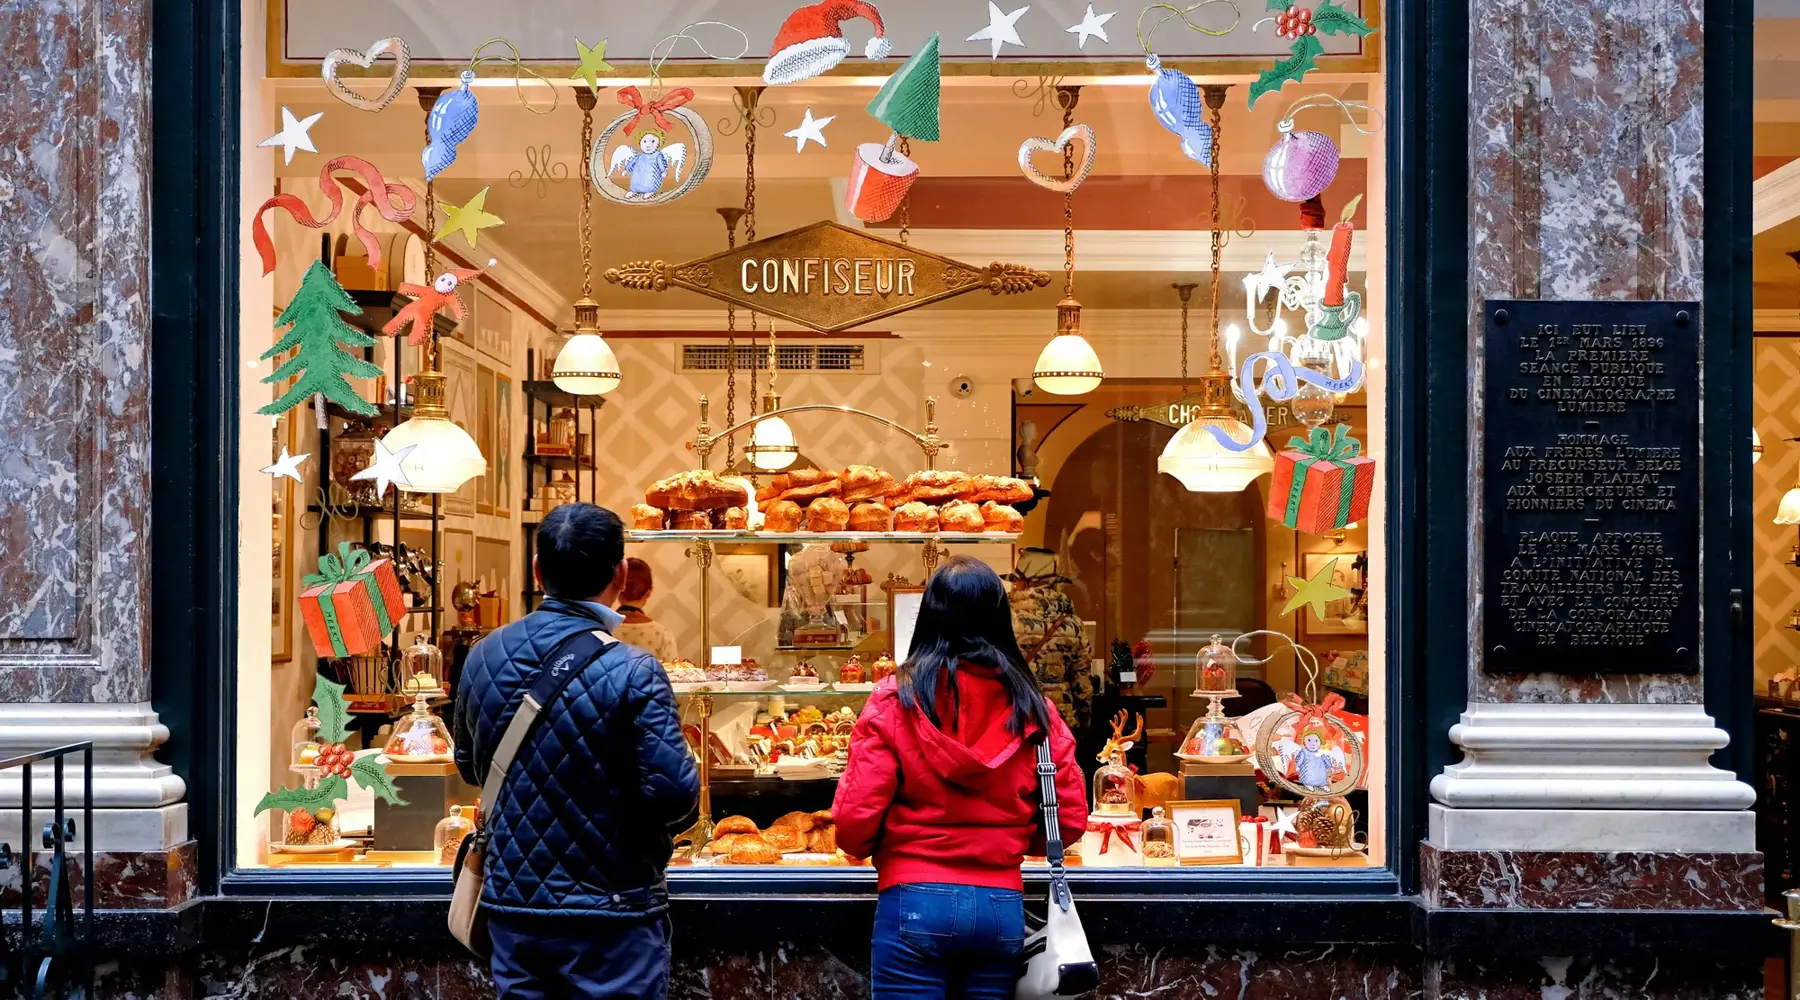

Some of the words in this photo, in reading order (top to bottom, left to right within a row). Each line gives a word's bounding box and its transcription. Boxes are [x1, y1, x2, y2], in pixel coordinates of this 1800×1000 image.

[740, 257, 916, 296] CONFISEUR
[1538, 324, 1558, 335] ICI
[1572, 325, 1602, 335] EUT
[1613, 325, 1646, 335] LIEU
[1520, 337, 1539, 347] LE
[1580, 337, 1622, 348] MARS
[1535, 350, 1555, 360] LA
[1568, 351, 1649, 361] PREMIERE
[1520, 363, 1579, 373] SEANCE
[1590, 363, 1664, 375] PUBLIQUE
[1543, 376, 1561, 386] EN
[1572, 376, 1645, 388] BELGIQUE
[1510, 389, 1528, 398] DU
[1537, 389, 1675, 400] CINEMATOGRAPHE
[1558, 402, 1626, 412] LUMIERE
[1557, 434, 1629, 445] HOMMAGE
[1504, 447, 1535, 457] AUX
[1545, 447, 1603, 458] FRERES
[1616, 448, 1680, 458] LUMIERE
[1501, 460, 1521, 470] AU
[1529, 460, 1627, 471] PRECURSEUR
[1636, 461, 1681, 471] BELGE
[1525, 473, 1584, 483] JOSEPH
[1593, 473, 1659, 484] PLATEAU
[1507, 486, 1537, 496] AUX
[1547, 486, 1645, 496] CHERCHEURS
[1657, 486, 1676, 497] ET
[1506, 499, 1585, 509] PIONNIERS
[1595, 499, 1614, 509] DU
[1622, 499, 1676, 510] CINEMA
[1520, 532, 1578, 543] PLAQUE
[1593, 532, 1662, 543] APPOSEE
[1518, 544, 1537, 554] LE
[1577, 544, 1620, 555] MARS
[1511, 557, 1522, 567] A
[1655, 558, 1673, 568] DU
[1503, 570, 1560, 580] COMITE
[1570, 570, 1645, 581] NATIONAL
[1652, 571, 1680, 581] DES
[1500, 582, 1614, 594] TRAVAILLEURS
[1622, 584, 1641, 594] DU
[1650, 584, 1683, 594] FILM
[1500, 596, 1519, 606] ET
[1527, 596, 1564, 606] AVEC
[1575, 596, 1592, 606] LE
[1604, 597, 1679, 607] CONCOURS
[1509, 609, 1526, 619] DE
[1538, 609, 1556, 619] LA
[1569, 609, 1672, 620] CORPORATION
[1513, 621, 1669, 635] CINEMATOGRAPHIQUE
[1538, 634, 1555, 644] DE
[1570, 635, 1644, 647] BELGIQUE
